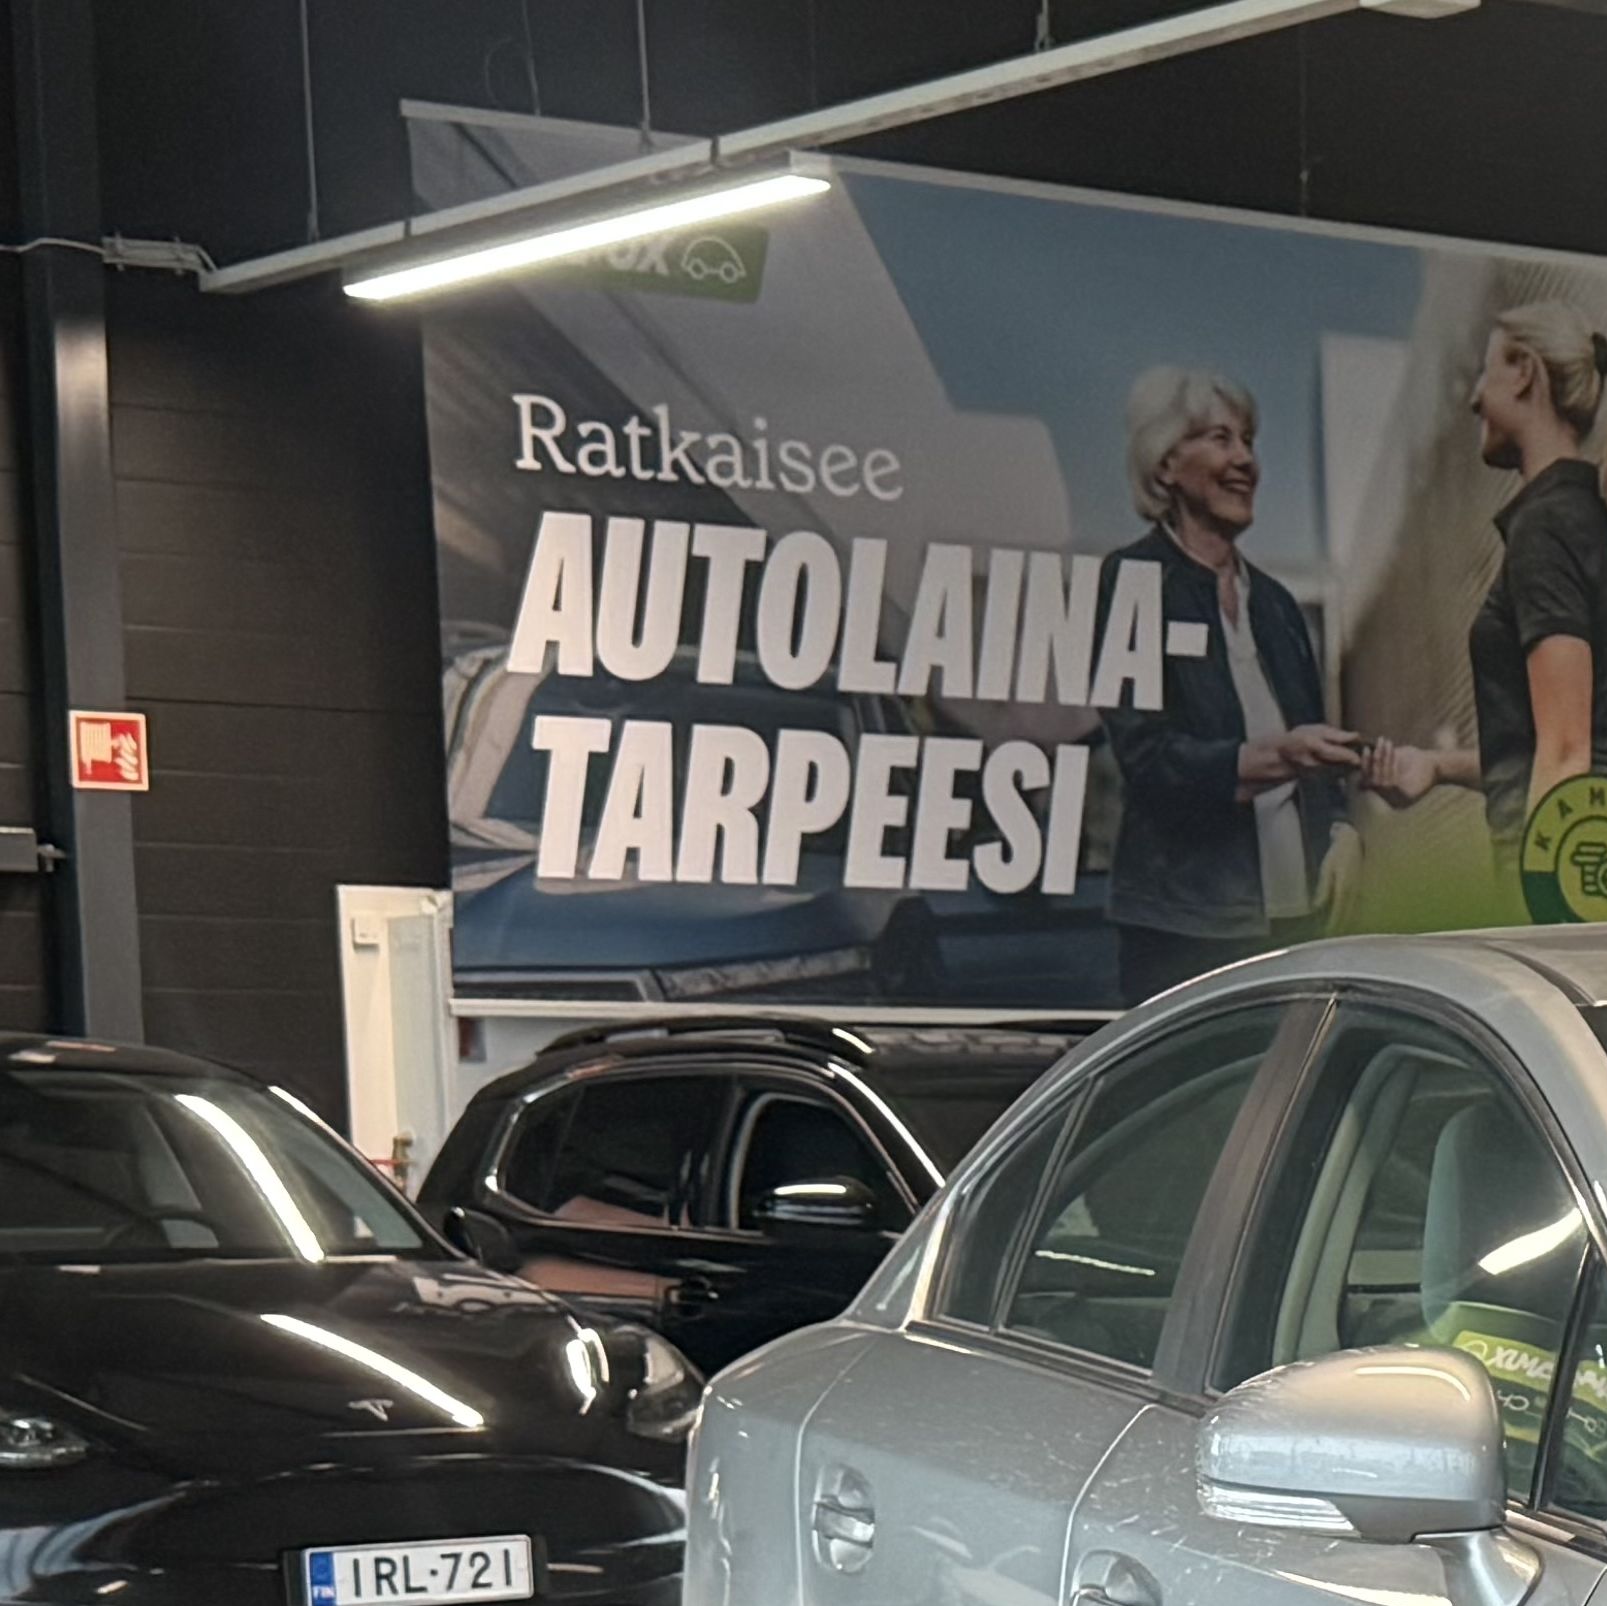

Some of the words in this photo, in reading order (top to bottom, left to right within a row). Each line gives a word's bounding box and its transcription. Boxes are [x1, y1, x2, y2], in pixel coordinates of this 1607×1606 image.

[511, 393, 904, 501] Ratkaisee
[506, 511, 1209, 711] AUTOLAINA-
[531, 715, 1090, 896] TARPEESI
[352, 1548, 513, 1598] IRL-721
